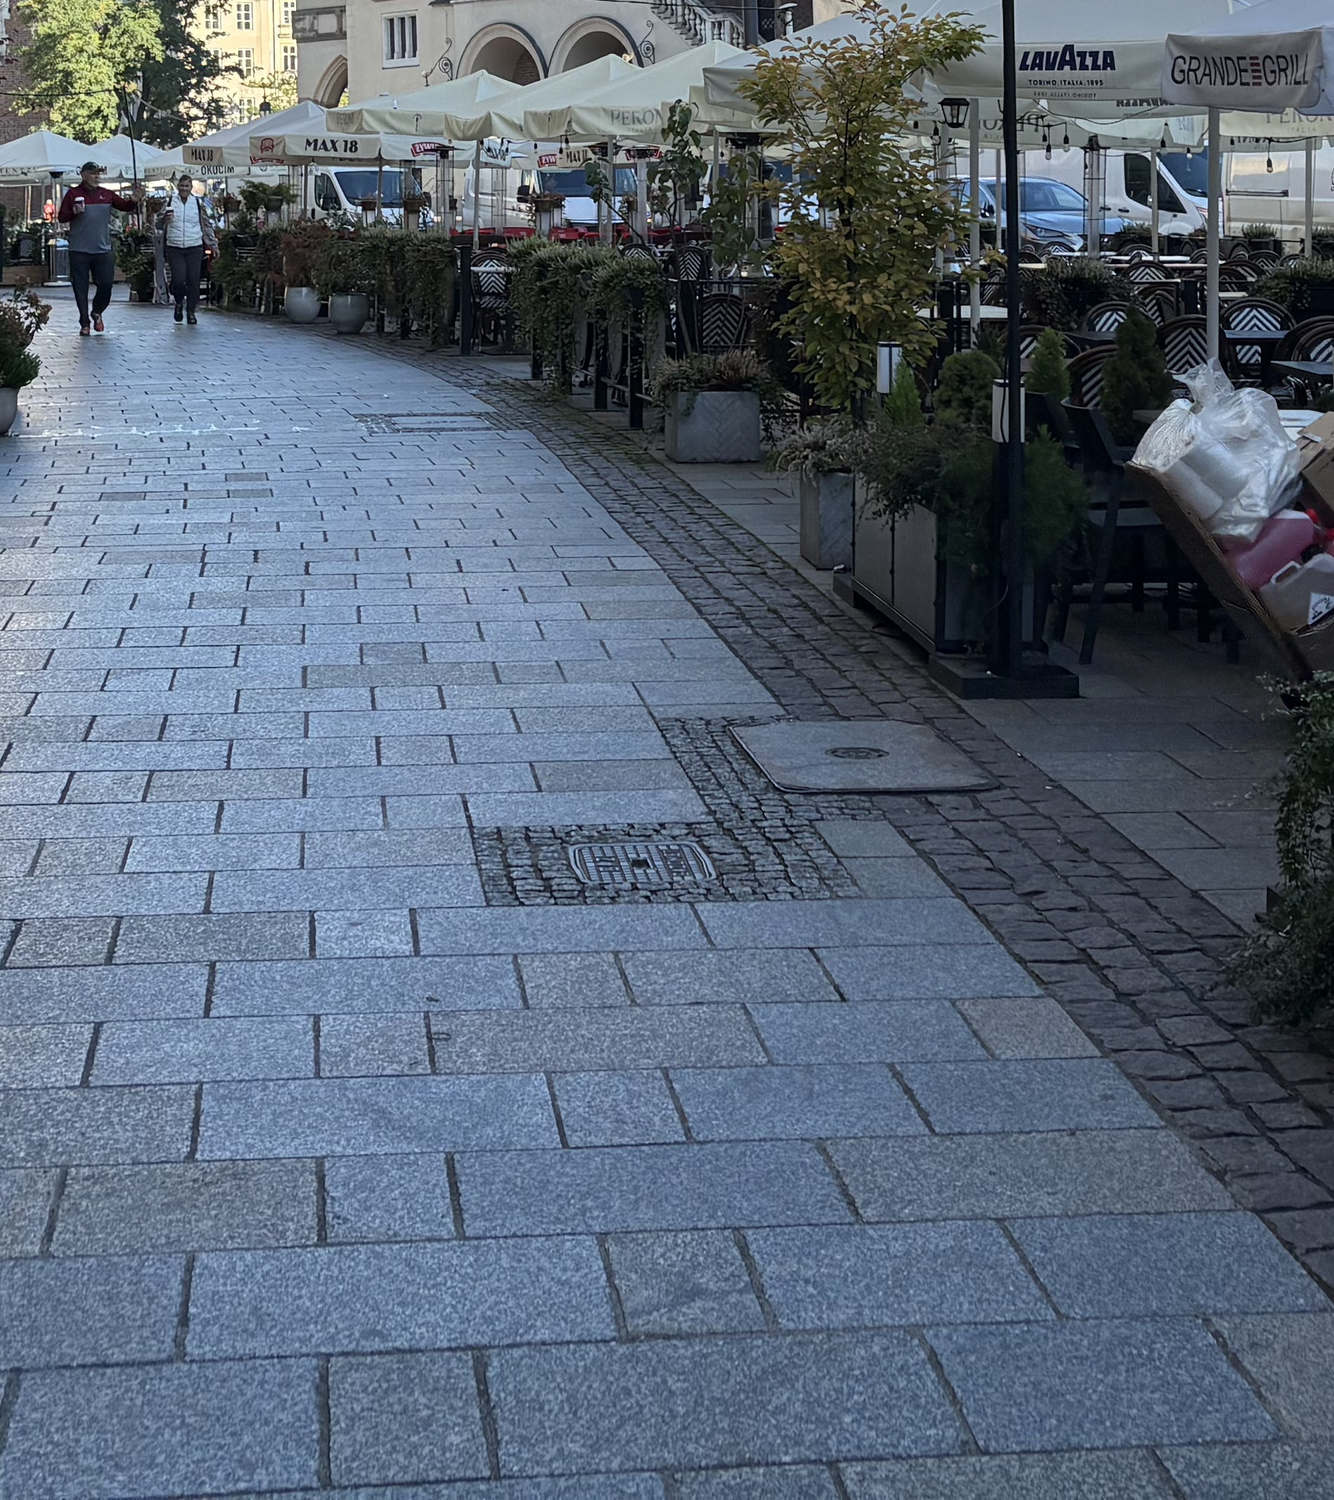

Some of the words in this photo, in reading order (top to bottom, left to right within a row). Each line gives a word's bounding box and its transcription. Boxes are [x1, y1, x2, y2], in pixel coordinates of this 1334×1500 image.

[1019, 44, 1116, 71] LAVAZZA
[1170, 55, 1250, 87] GRANDE
[1262, 53, 1309, 86] GRILL
[611, 108, 662, 127] PERON
[304, 138, 339, 154] MAX
[342, 139, 359, 154] 18
